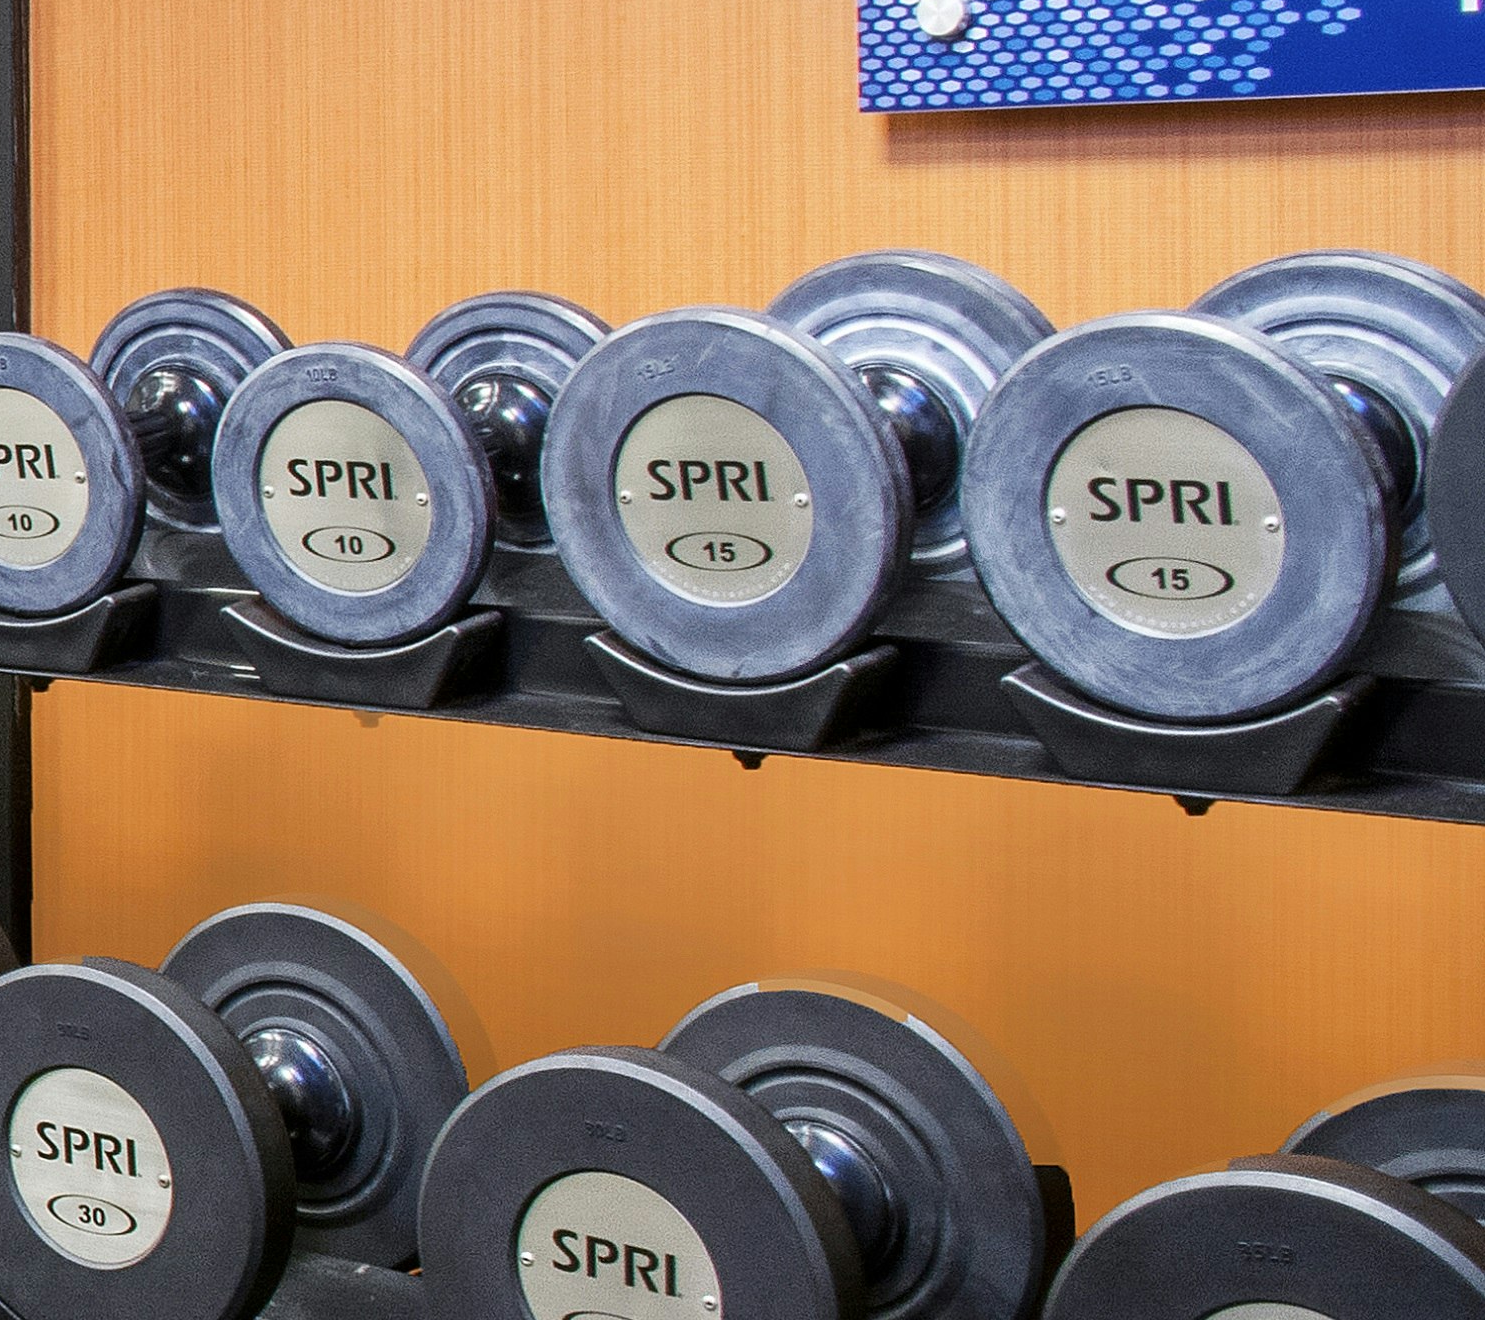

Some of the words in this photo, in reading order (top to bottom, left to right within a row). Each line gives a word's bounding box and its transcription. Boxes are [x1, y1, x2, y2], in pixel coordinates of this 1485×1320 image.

[287, 459, 393, 500] SPRI
[647, 460, 769, 501] SPRI
[1088, 477, 1233, 525] SPRI
[8, 513, 32, 531] 10
[334, 535, 363, 555] 10
[703, 541, 736, 563] 15
[1151, 568, 1190, 591] 15
[37, 1122, 137, 1177] SPRI
[78, 1205, 106, 1227] 30
[553, 1229, 681, 1297] SPRI
